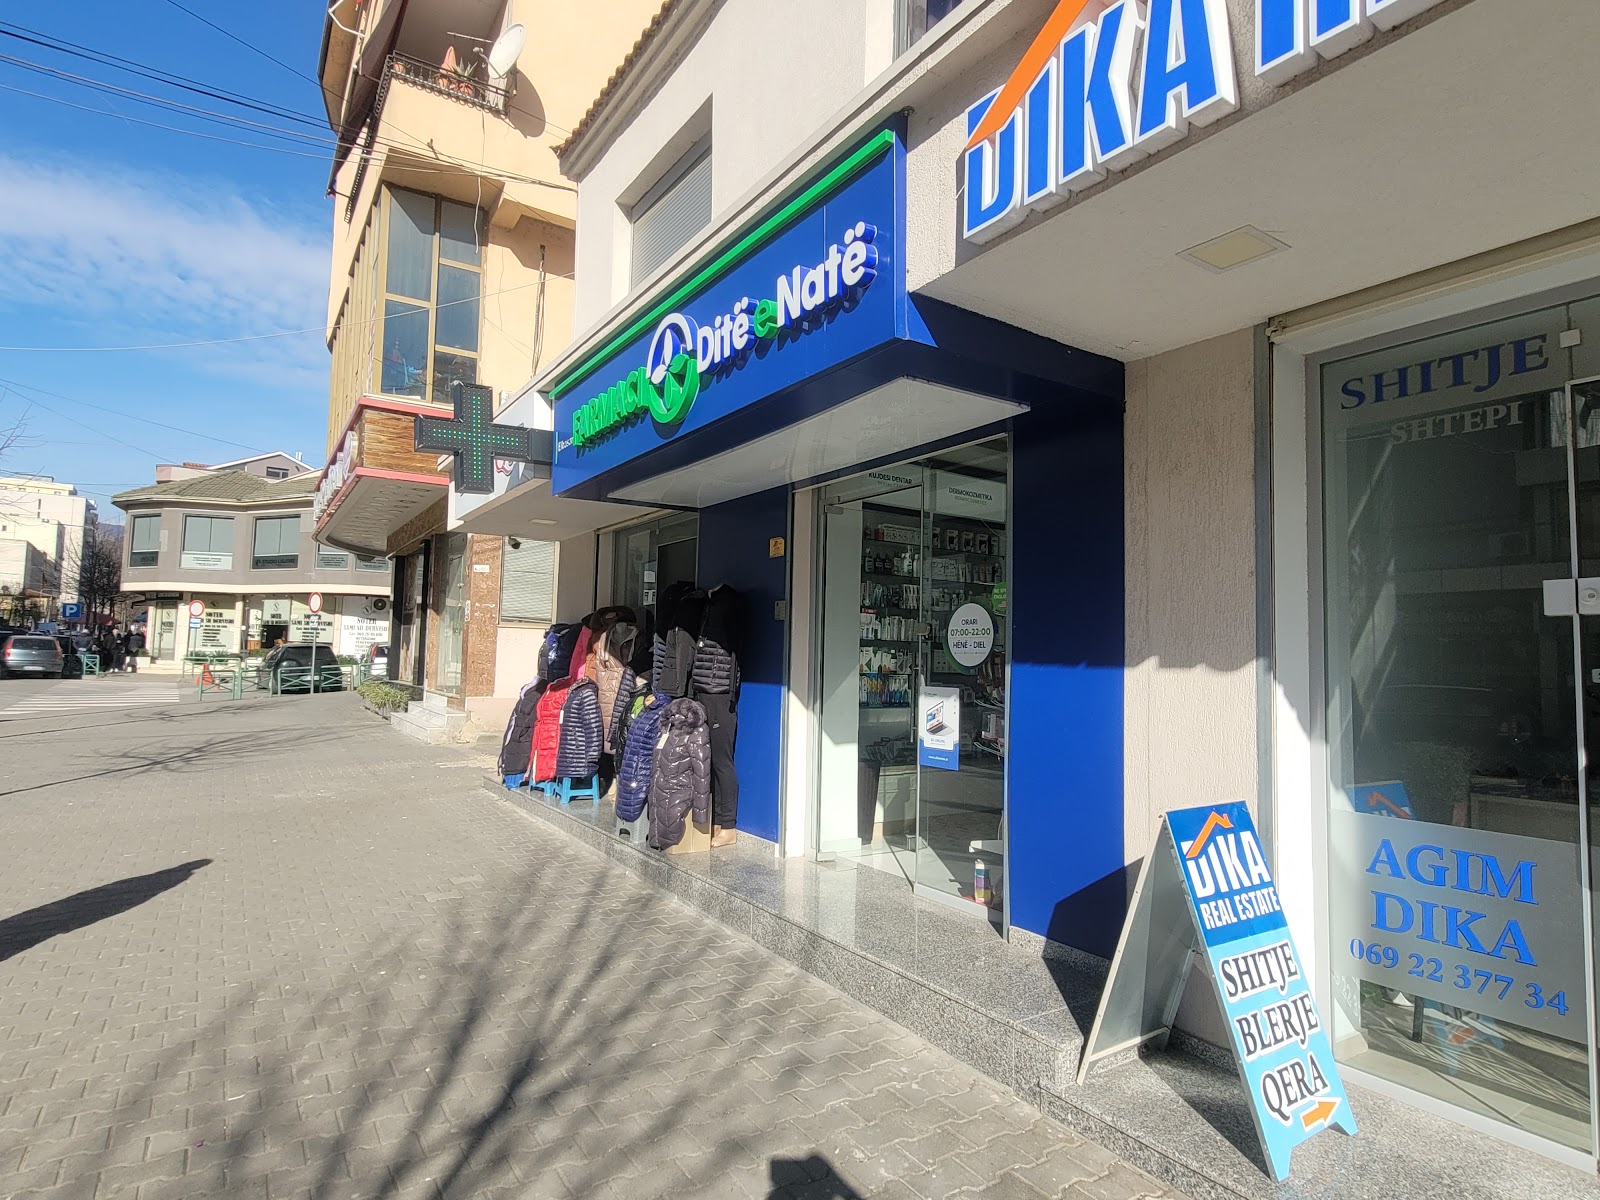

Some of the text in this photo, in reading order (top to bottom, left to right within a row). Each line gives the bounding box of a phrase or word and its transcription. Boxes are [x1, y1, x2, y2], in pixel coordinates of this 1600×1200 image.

[963, 0, 1236, 242] DIKA
[573, 221, 874, 446] FARMACI Ditë e Natë
[1341, 333, 1549, 410] SHITJE
[1390, 401, 1523, 445] SHTEPI
[868, 472, 913, 485] KUJDESI DENTAR
[948, 486, 993, 501] DERMOKOZMETIKA
[66, 604, 77, 616] P
[950, 628, 991, 637] 07:00-22:00
[973, 641, 986, 649] DIEL
[1180, 830, 1272, 899] DIKA
[1365, 838, 1539, 905] AGIM
[1200, 887, 1281, 930] REAL ESTATE
[1370, 890, 1538, 967] DIKA
[1220, 942, 1298, 998] SHITJE
[1350, 938, 1568, 1016] 069 22 377 34
[1236, 993, 1319, 1057] BLERJE
[1262, 1054, 1329, 1121] QERA
